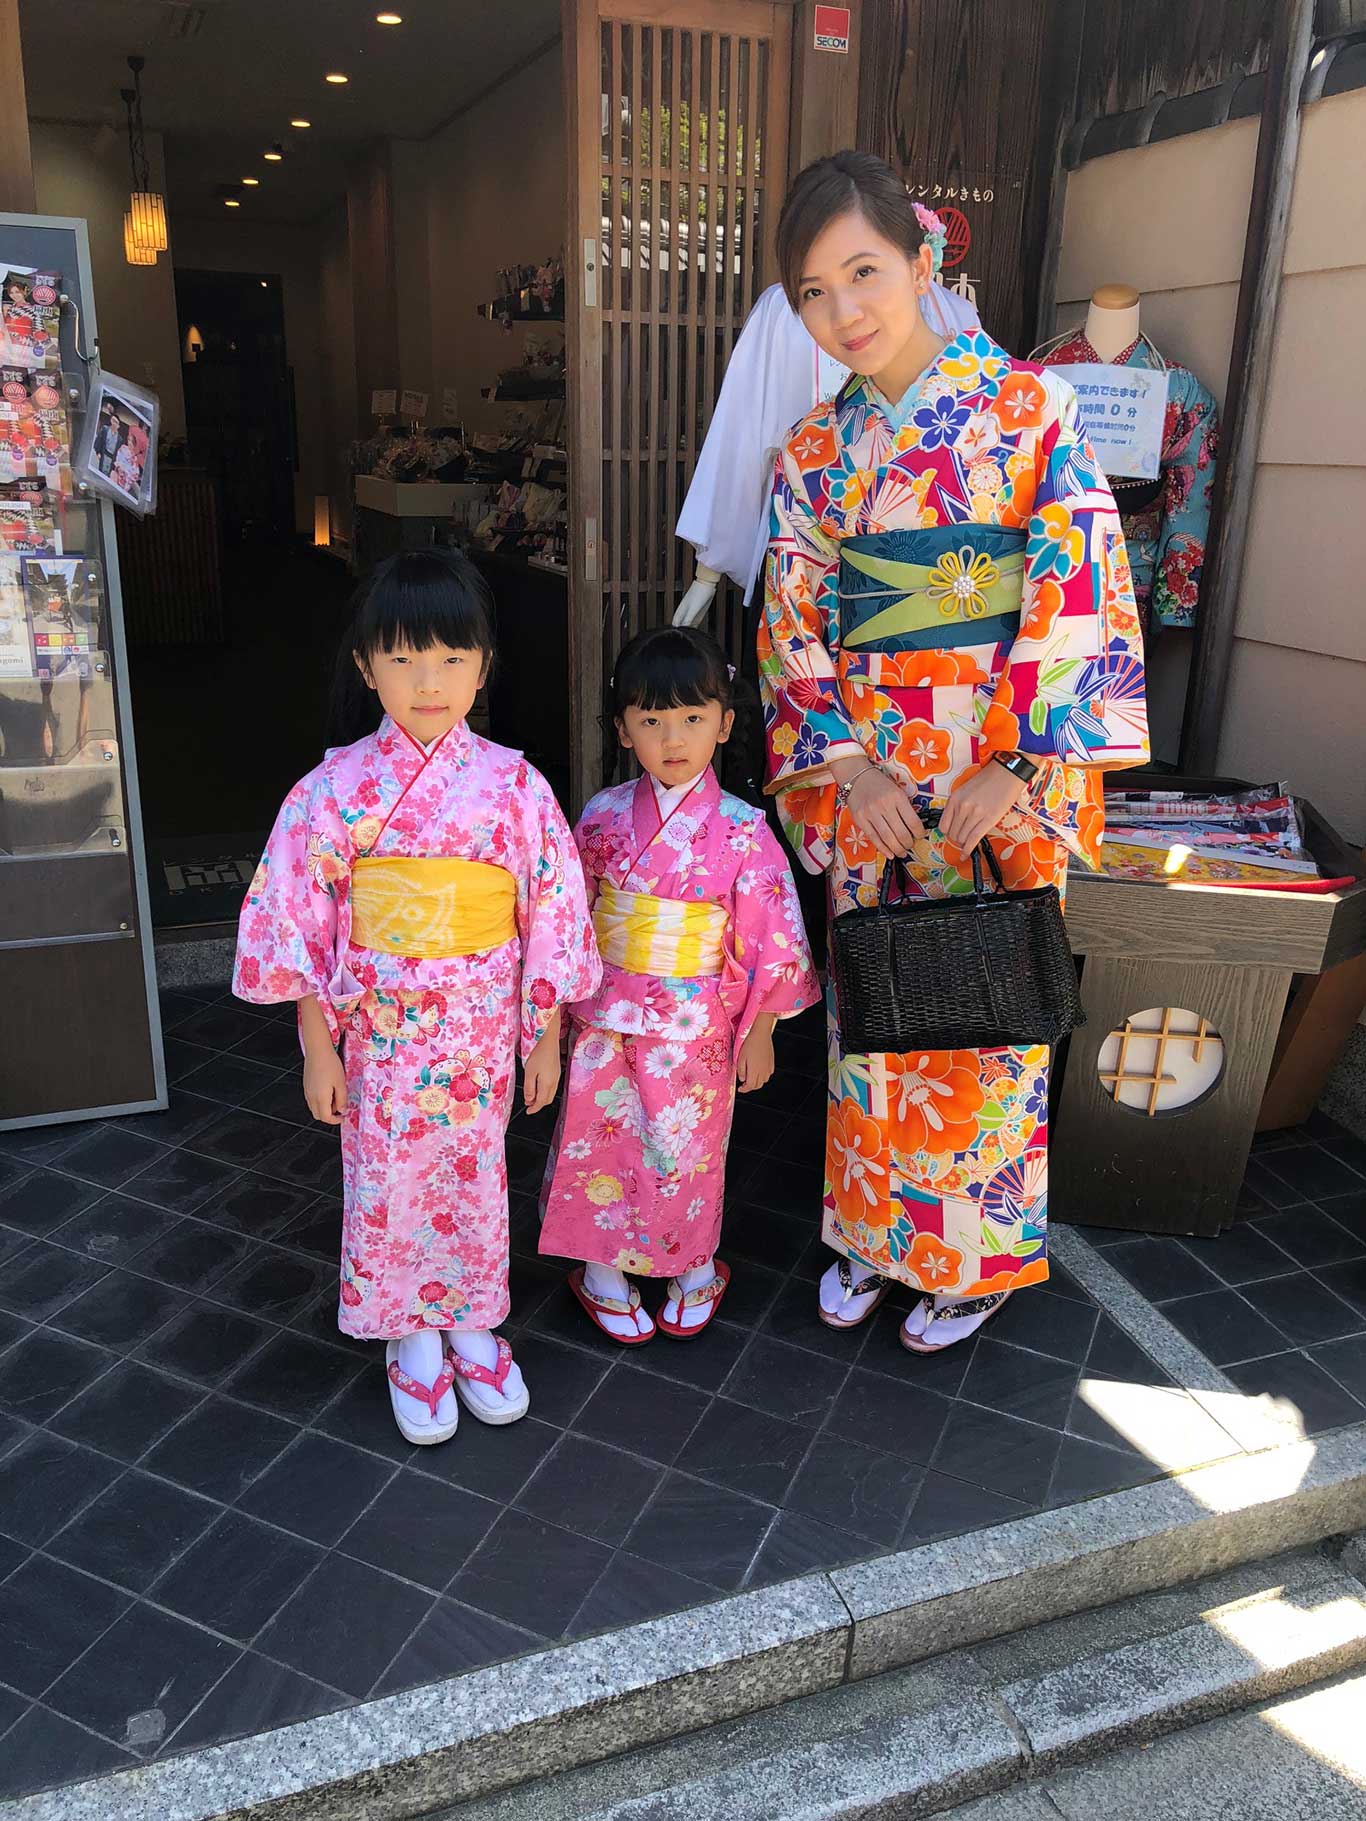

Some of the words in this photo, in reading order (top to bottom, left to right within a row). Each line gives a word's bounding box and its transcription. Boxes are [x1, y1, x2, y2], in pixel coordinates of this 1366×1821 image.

[816, 36, 847, 48] SECOM
[905, 184, 994, 203] レンタルきもの
[1110, 404, 1121, 416] 0
[1127, 407, 1138, 418] 分
